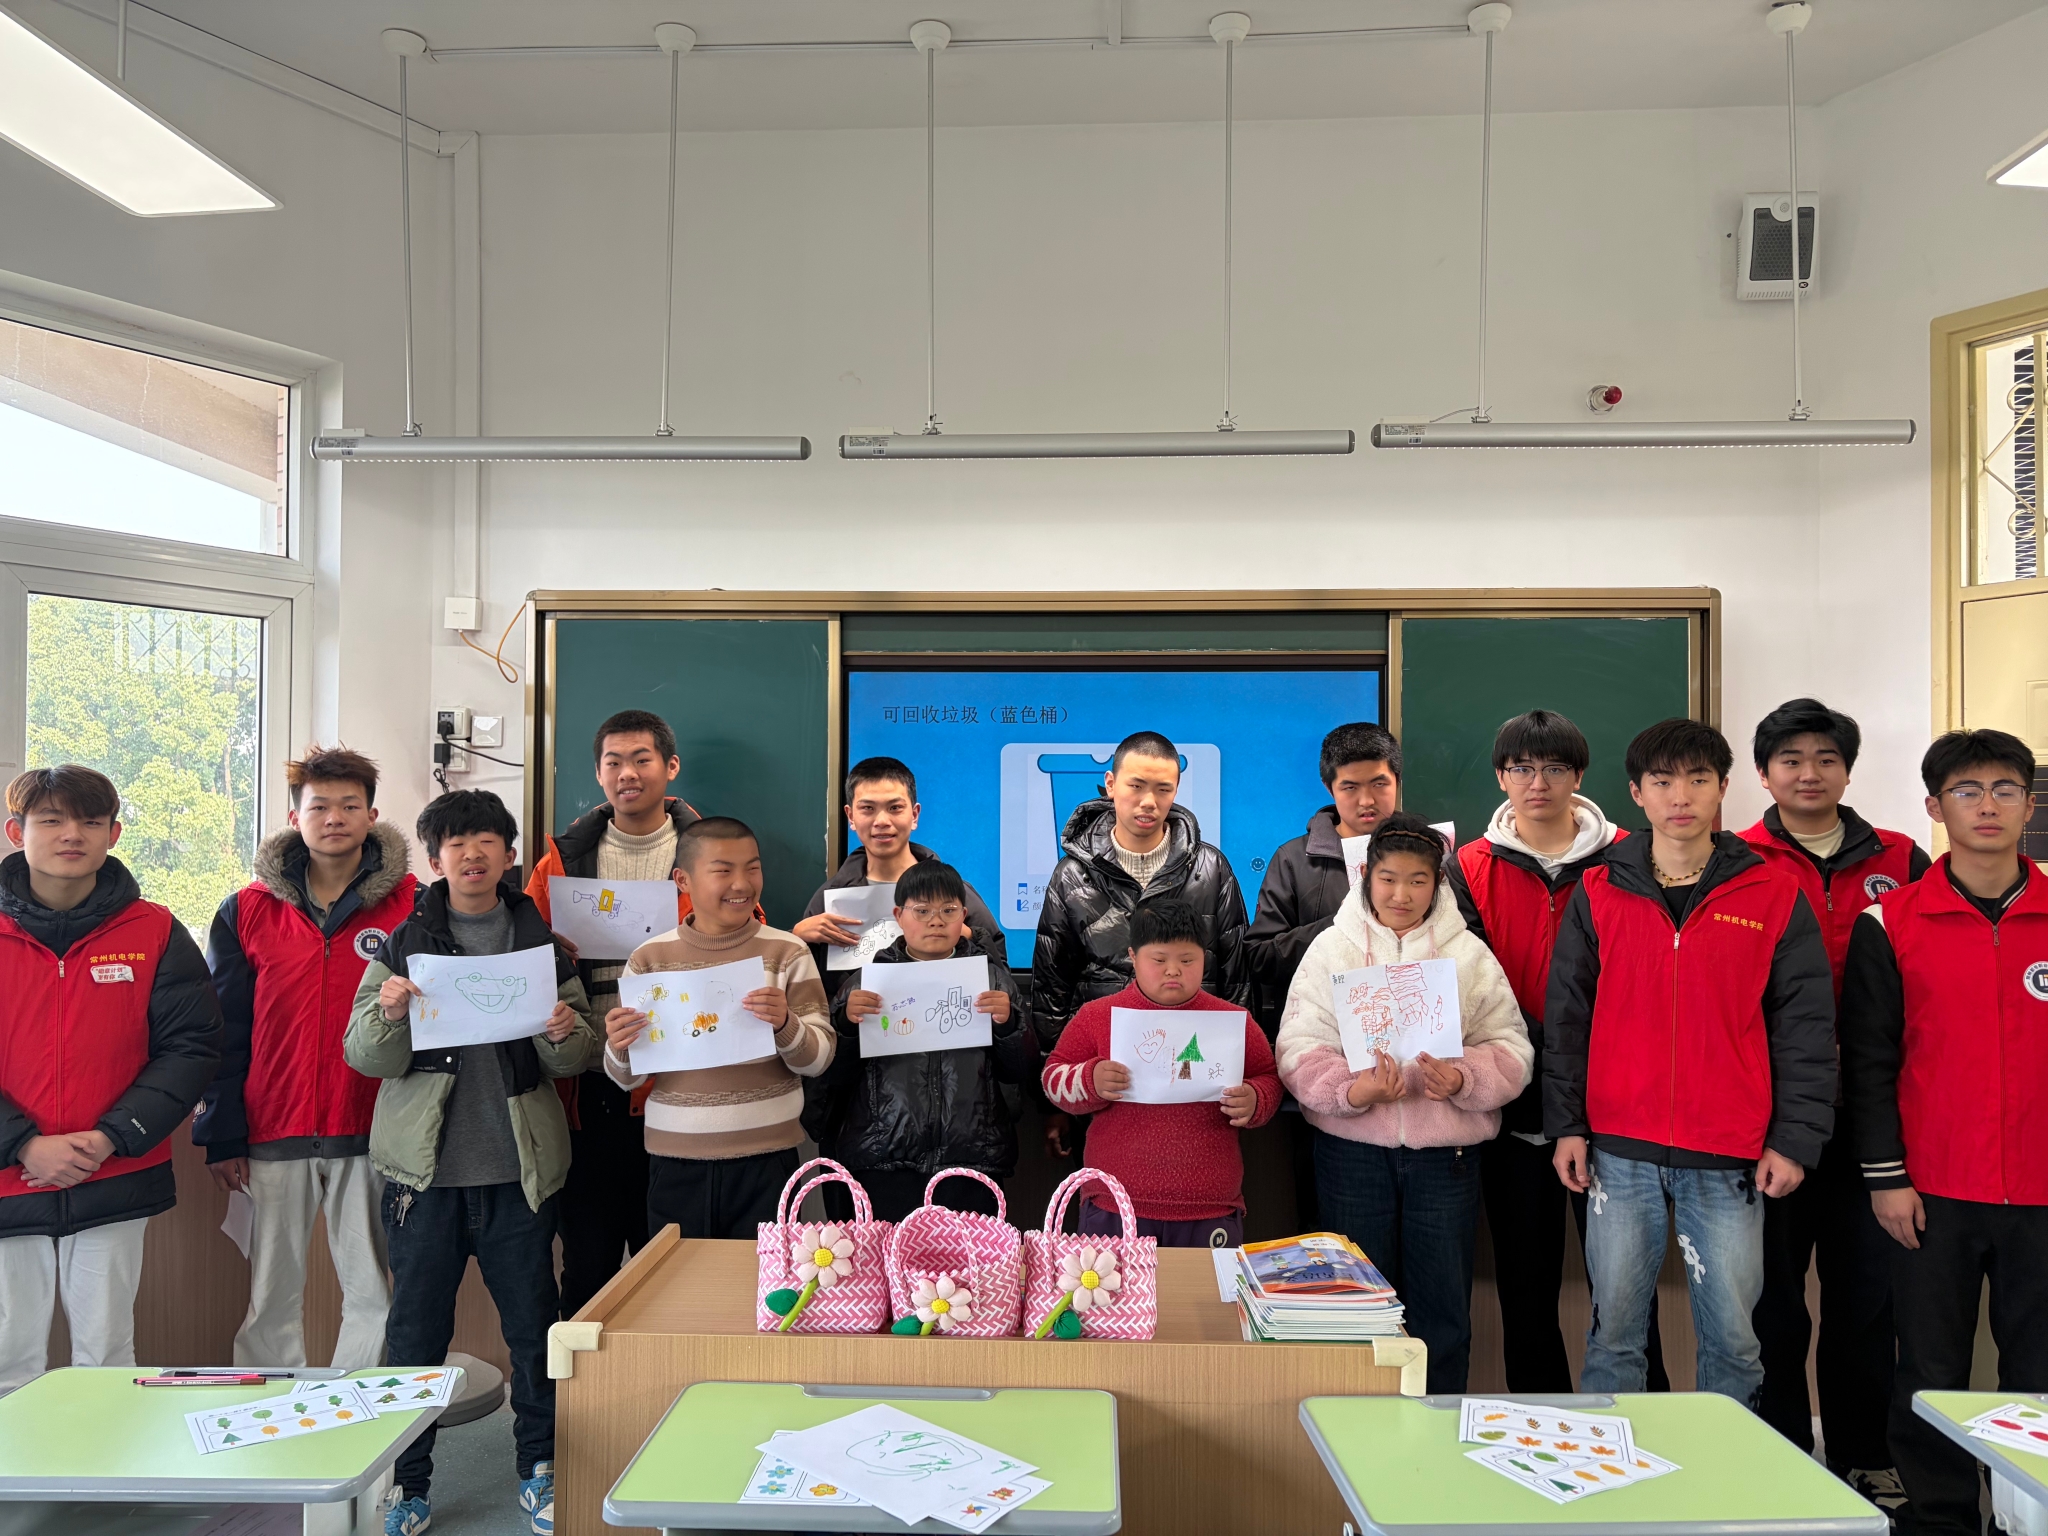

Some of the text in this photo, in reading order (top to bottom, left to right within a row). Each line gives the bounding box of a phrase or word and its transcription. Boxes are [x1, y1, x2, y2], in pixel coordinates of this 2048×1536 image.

[882, 705, 1069, 725] 可回收垃圾（蓝色桶）
[1713, 913, 1764, 931] 常州机电学院
[89, 953, 146, 964] 常州机电学院
